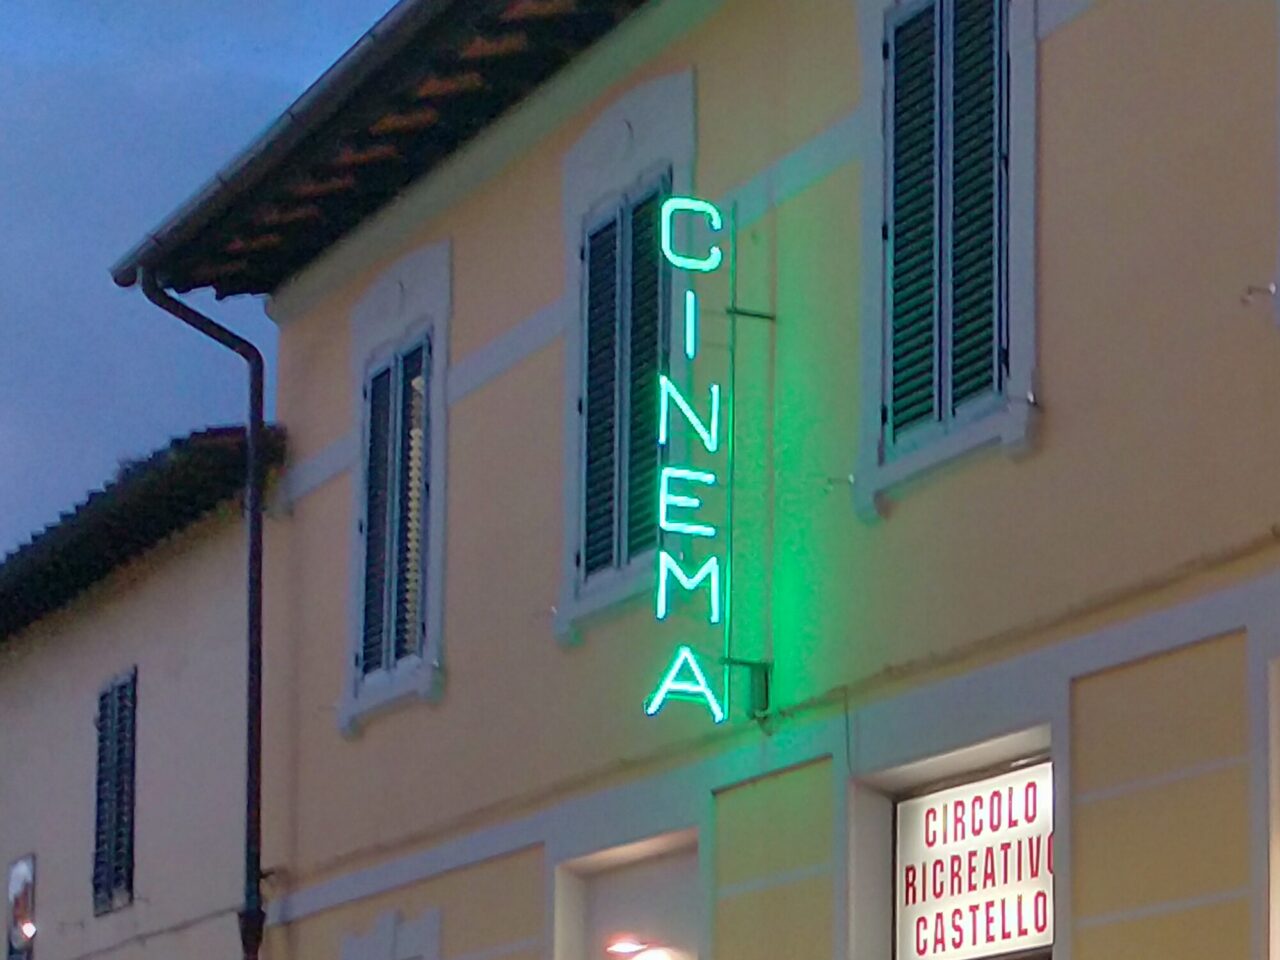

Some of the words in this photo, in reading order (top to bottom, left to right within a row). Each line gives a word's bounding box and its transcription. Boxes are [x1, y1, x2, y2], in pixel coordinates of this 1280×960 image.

[643, 195, 728, 724] CINEMA
[924, 781, 1038, 848] CIRCOLO
[915, 890, 1049, 957] CASTELLO
